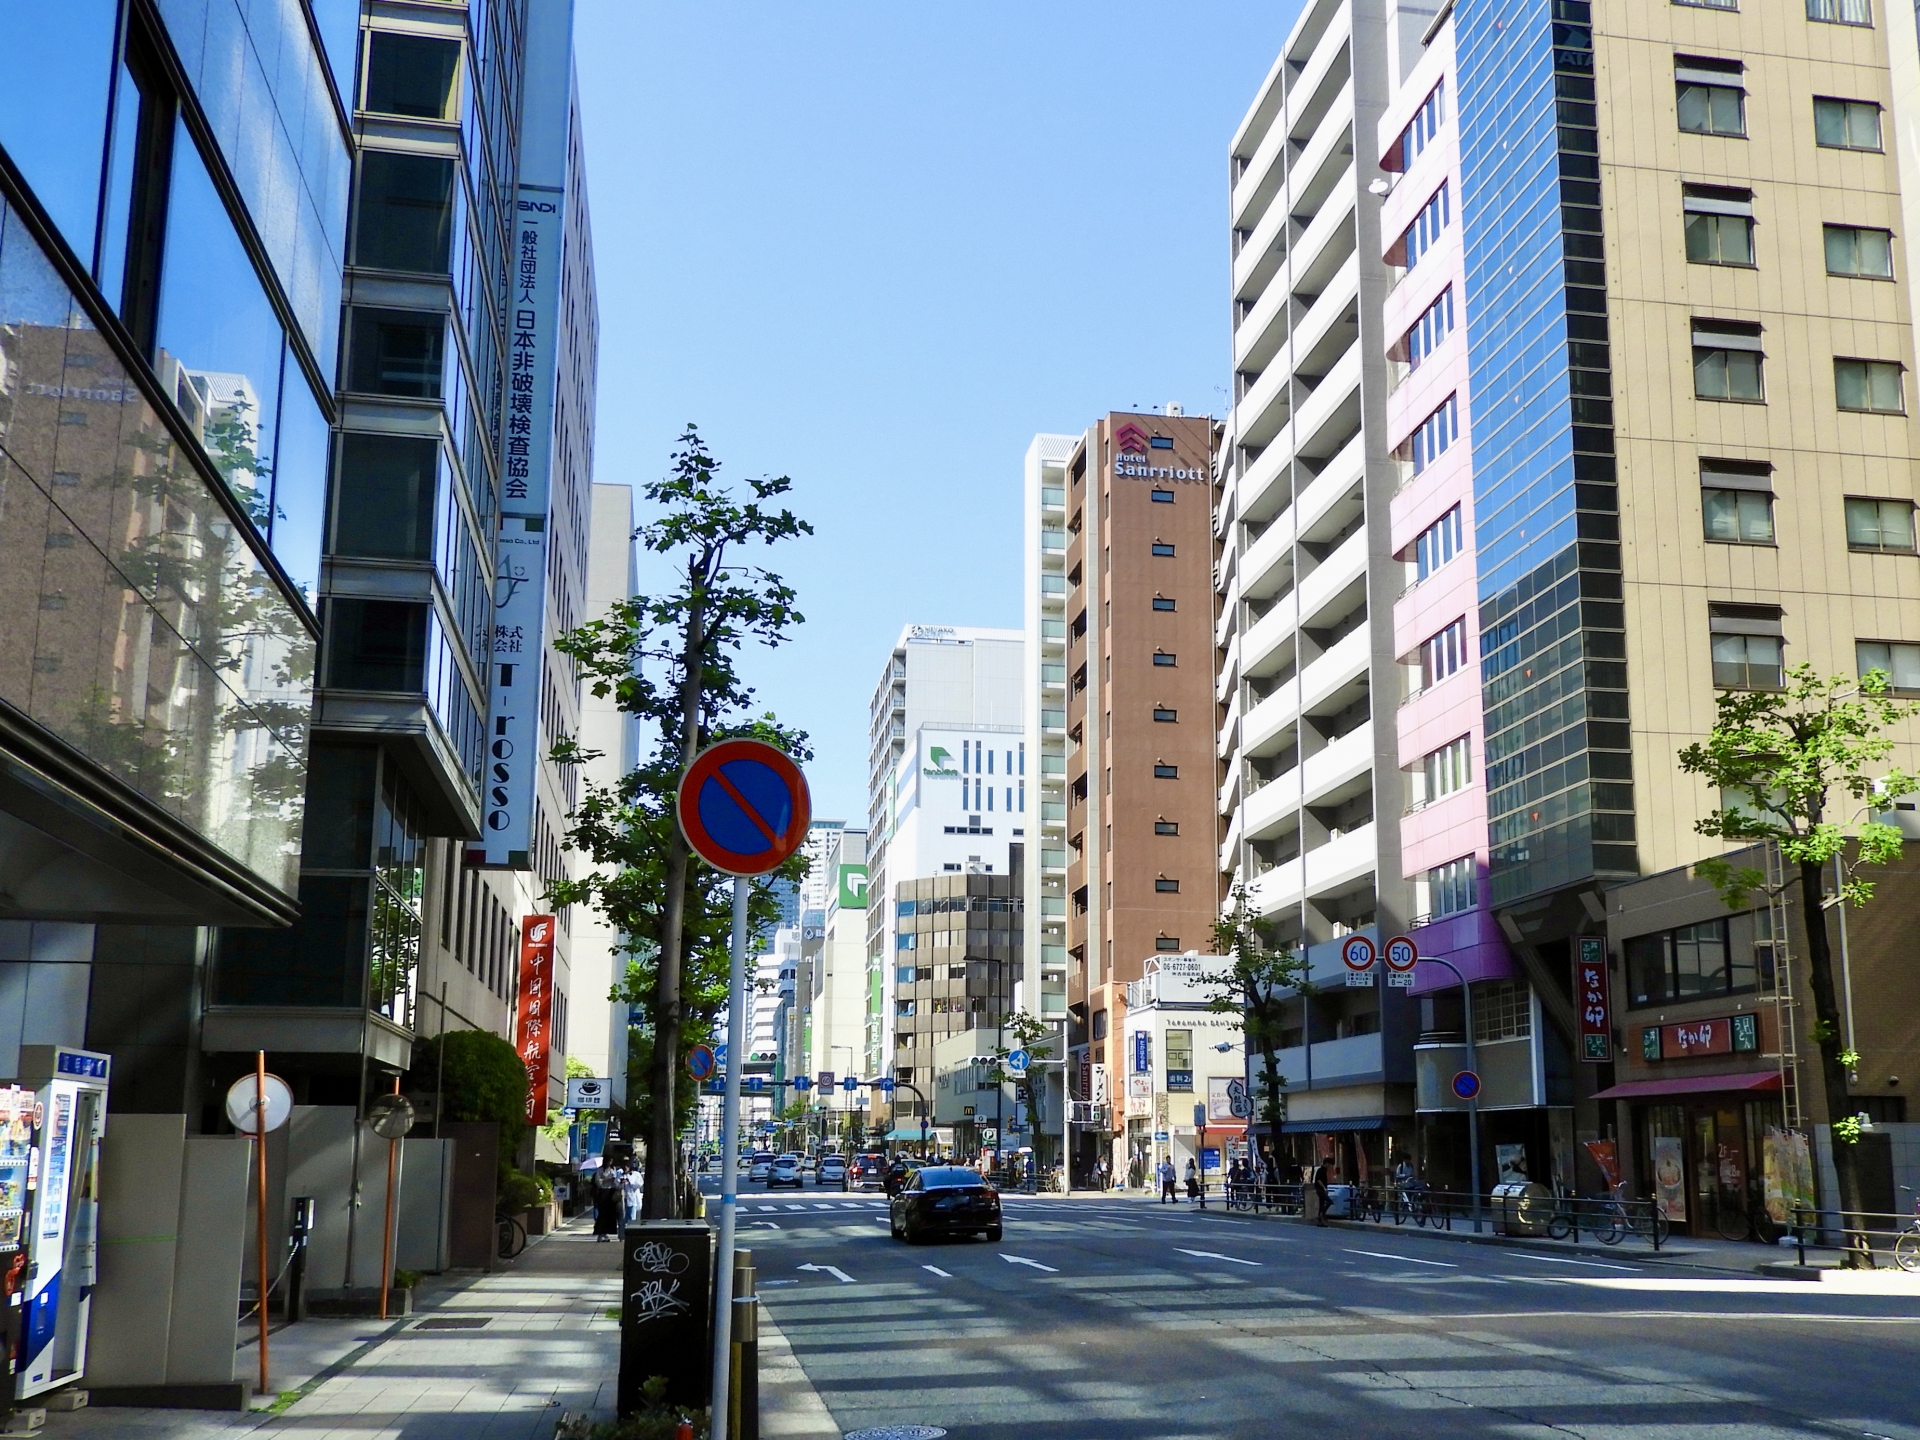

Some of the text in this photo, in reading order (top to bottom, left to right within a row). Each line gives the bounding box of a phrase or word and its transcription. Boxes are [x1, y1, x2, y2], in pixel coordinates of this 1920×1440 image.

[1116, 453, 1146, 463] Hotel
[1114, 462, 1204, 481] Sanrriott
[1350, 945, 1368, 961] 60
[1392, 946, 1411, 962] 50
[1677, 1024, 1712, 1049] なか卯
[1095, 1066, 1105, 1102] ラーメン
